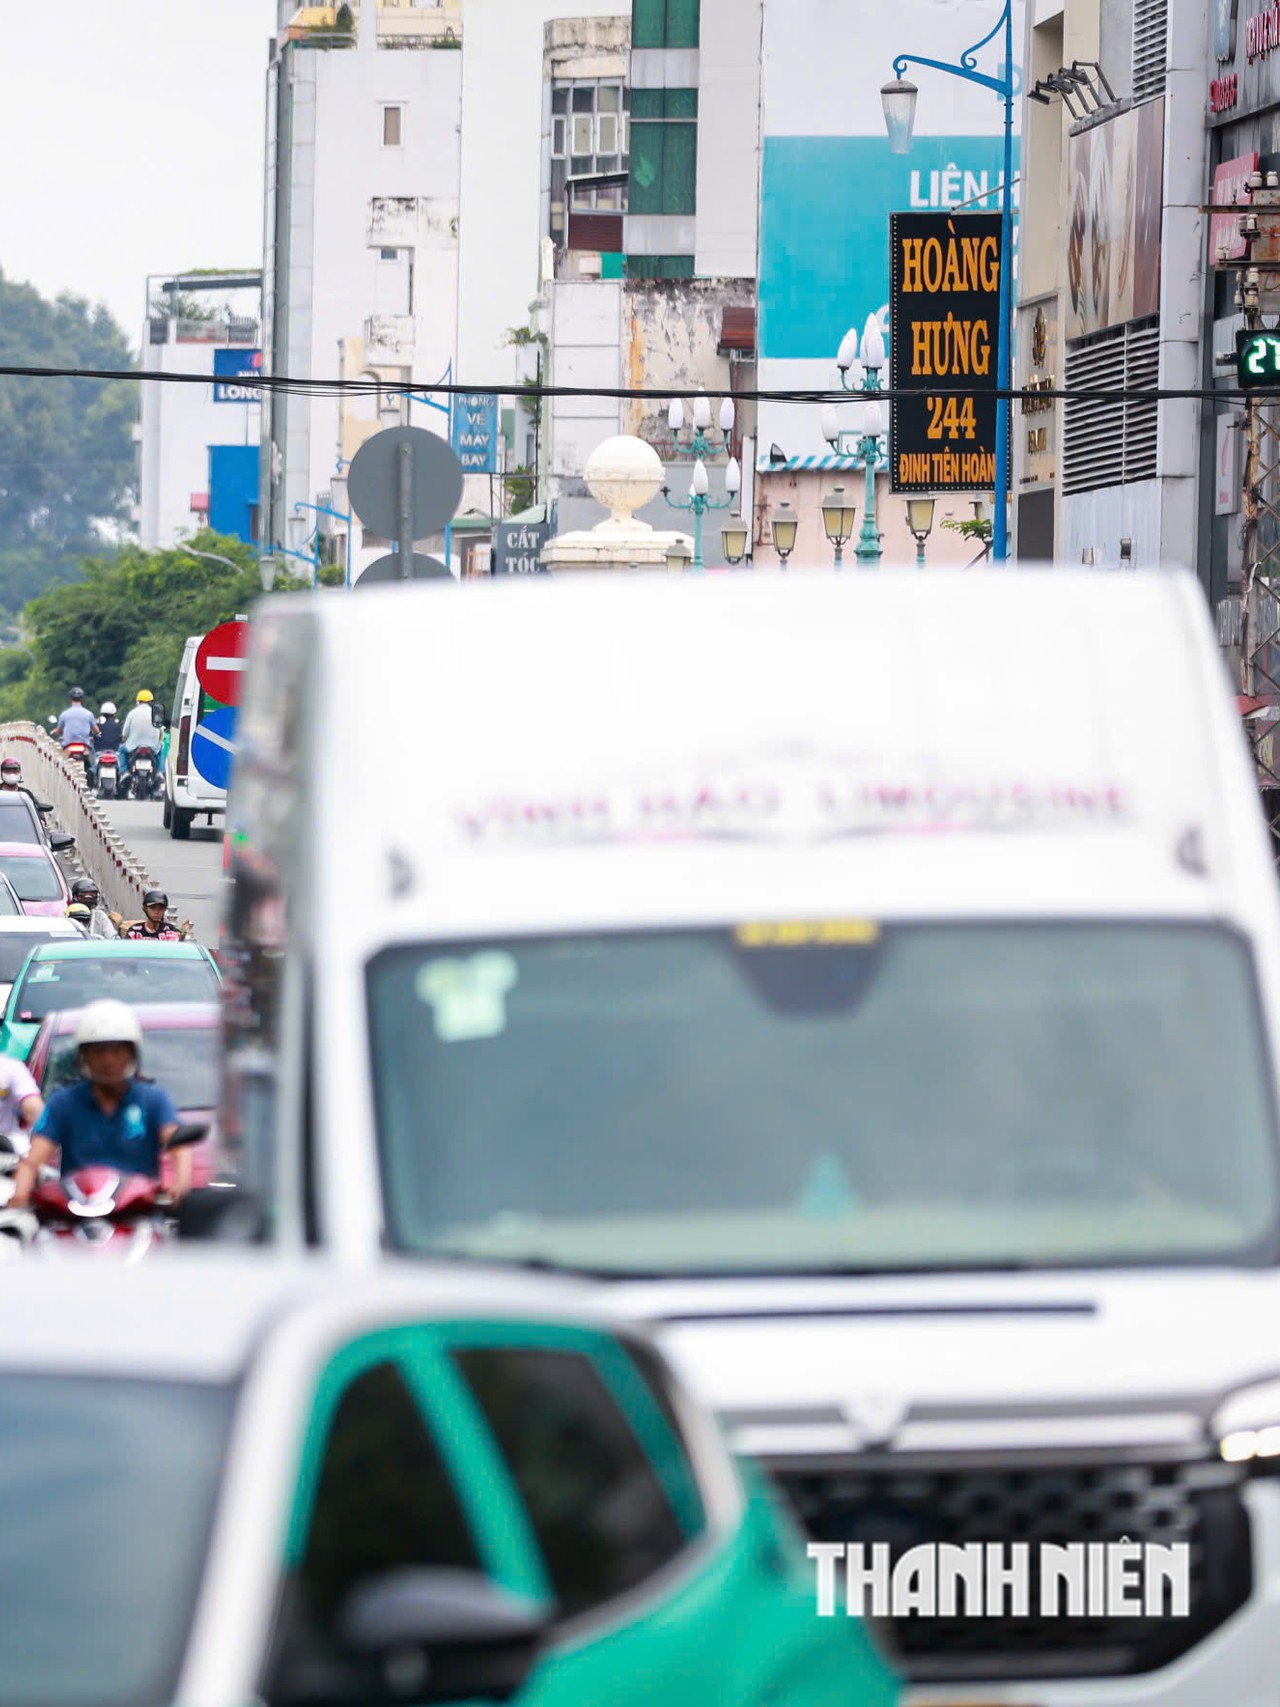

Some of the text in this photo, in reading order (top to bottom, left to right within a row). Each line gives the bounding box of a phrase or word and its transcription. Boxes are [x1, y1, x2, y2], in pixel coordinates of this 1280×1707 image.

[910, 162, 989, 208] LIÊN
[902, 219, 1000, 293] HOÀNG
[911, 311, 991, 376] HƯNG
[926, 396, 977, 439] 244
[461, 453, 487, 467] BAY
[899, 445, 996, 483] ĐINH TIÊN HOÀN
[506, 525, 540, 549] CẮT
[505, 552, 540, 573] TÓC
